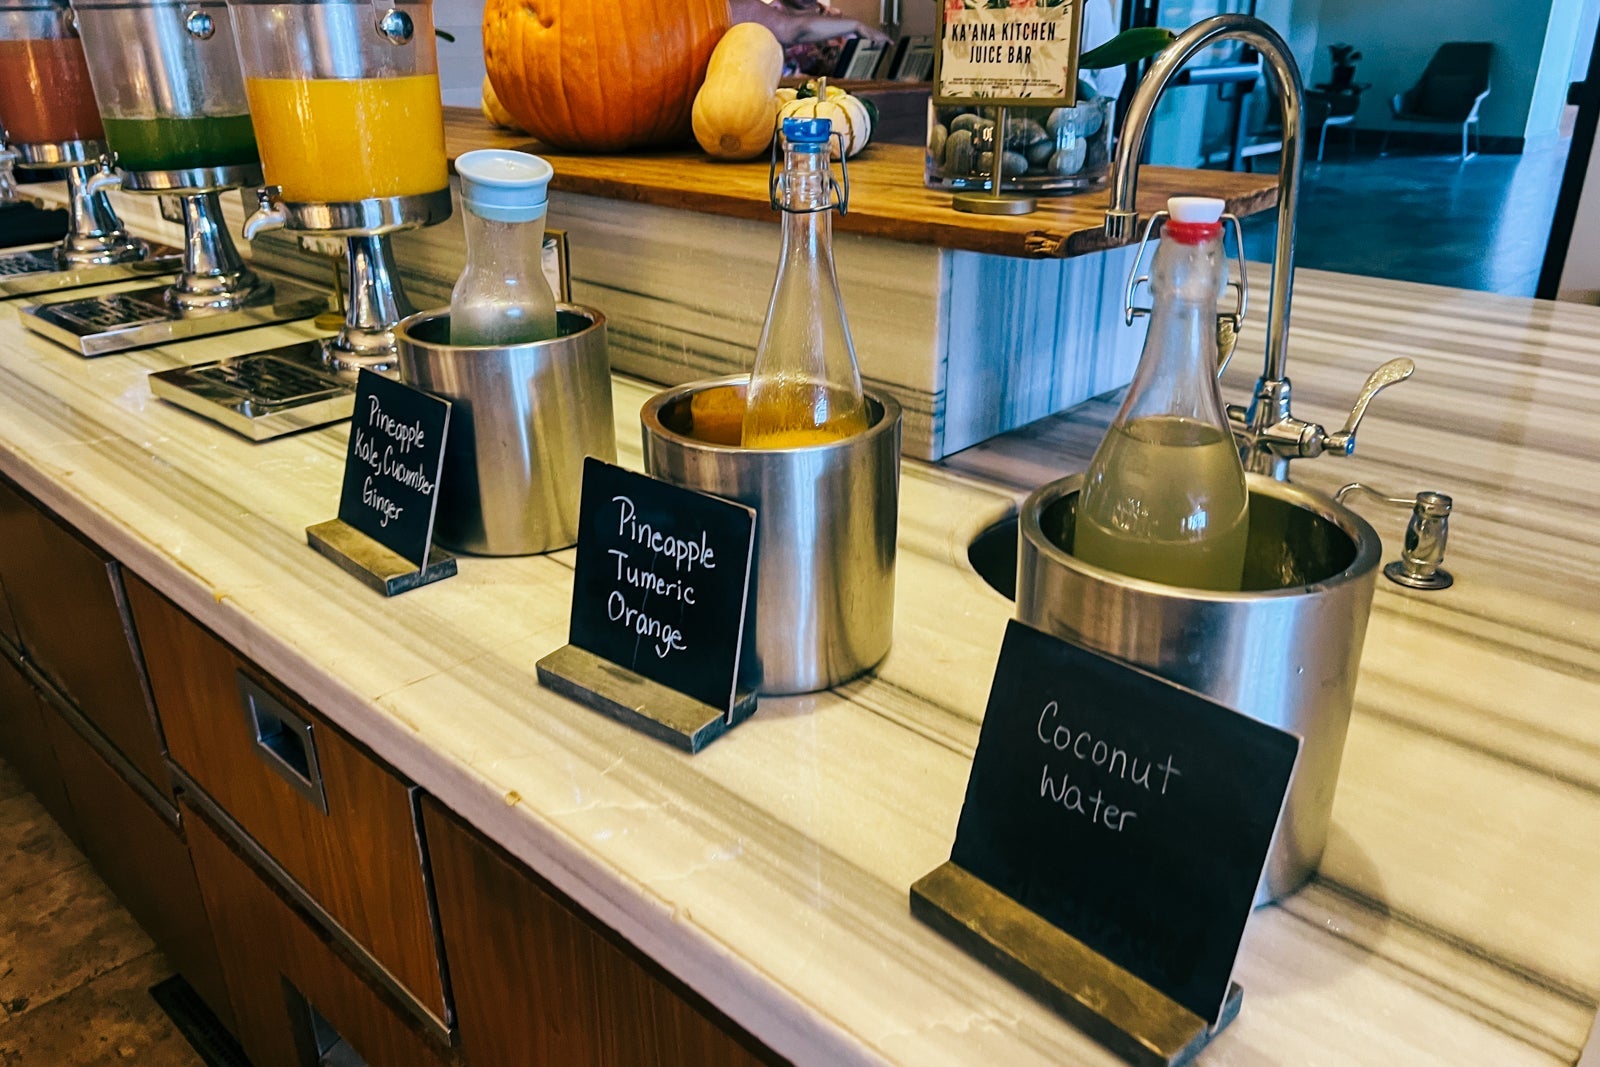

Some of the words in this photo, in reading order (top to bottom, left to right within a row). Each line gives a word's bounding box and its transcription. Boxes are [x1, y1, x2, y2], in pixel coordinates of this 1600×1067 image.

[951, 23, 996, 42] KA'ANA
[1001, 22, 1056, 41] KITCHEN
[969, 45, 1002, 64] JUICE
[1007, 45, 1032, 65] BAR
[368, 394, 425, 454] Pineapple
[354, 427, 382, 476] Kale,
[383, 444, 435, 495] Cucumber
[362, 475, 403, 527] Ginger
[612, 495, 716, 572] Pineapple
[607, 549, 696, 605] Tumeric
[607, 590, 687, 659] Orange
[1037, 700, 1182, 795] Coconut
[1040, 763, 1138, 832] Water
